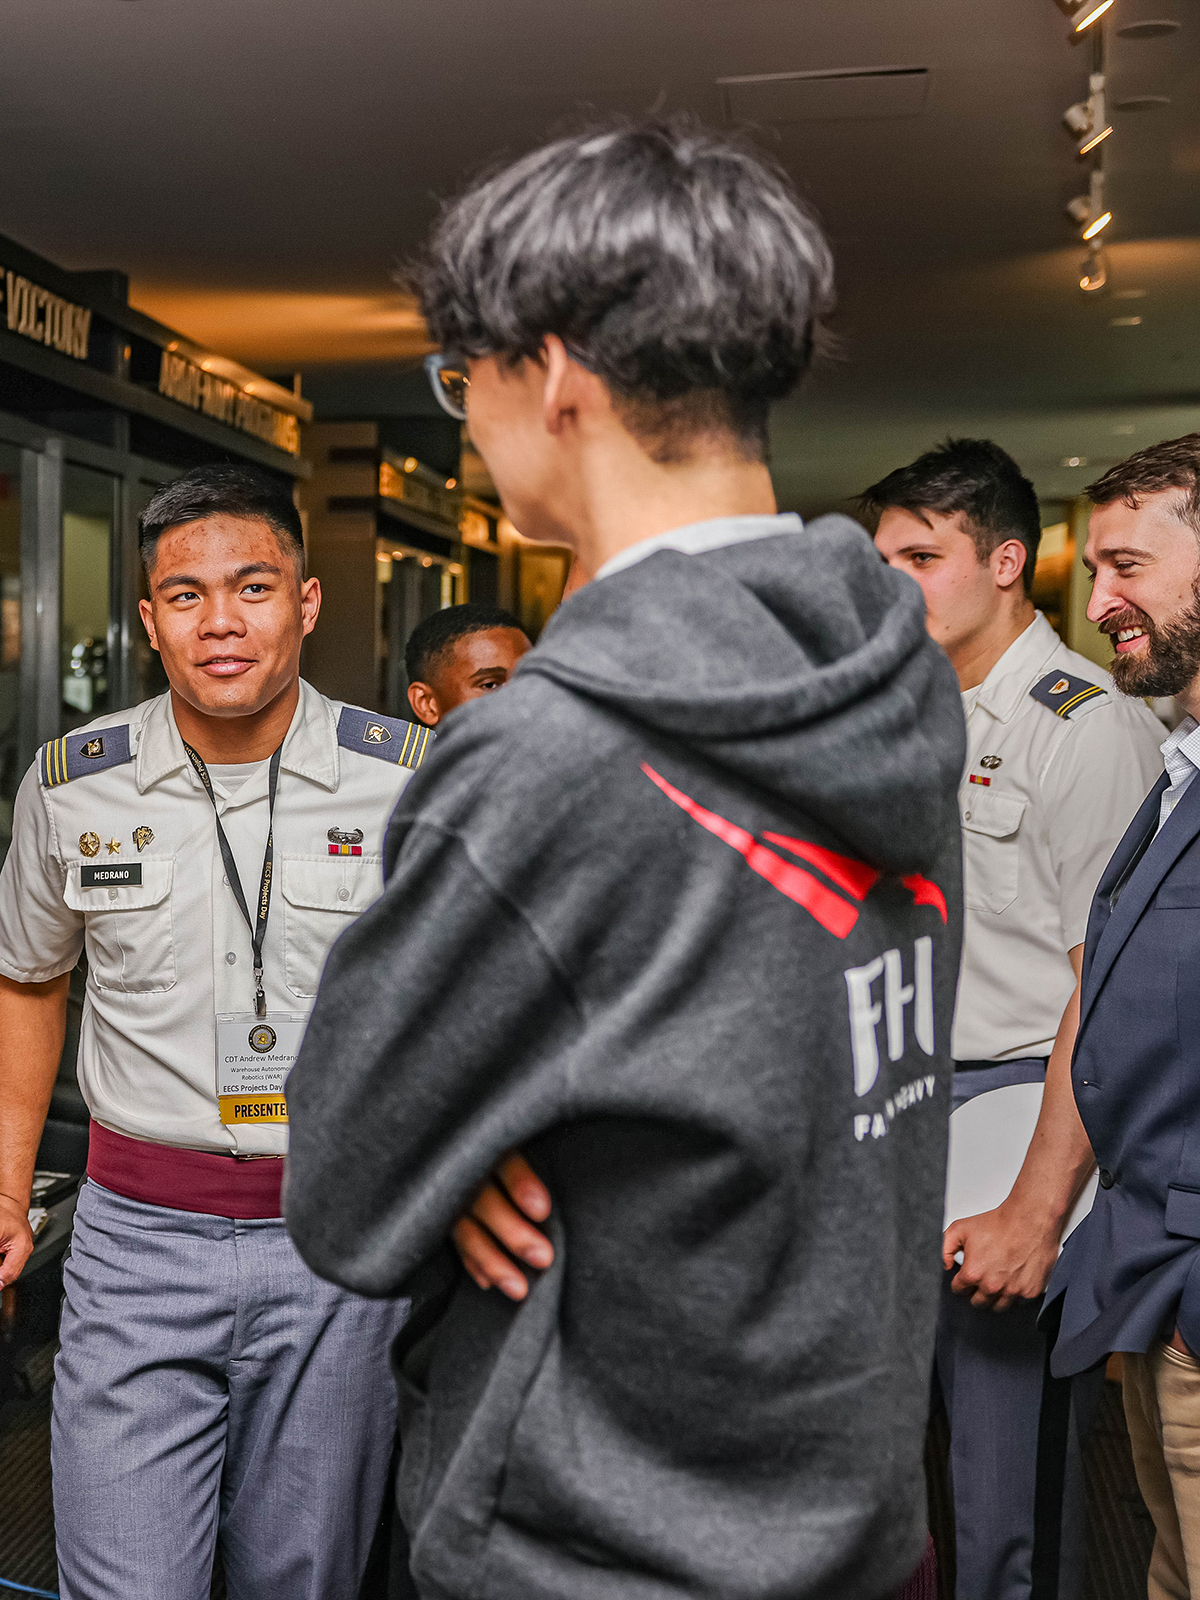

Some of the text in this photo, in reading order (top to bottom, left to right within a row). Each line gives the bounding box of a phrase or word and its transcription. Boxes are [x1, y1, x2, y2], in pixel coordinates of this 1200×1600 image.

[6, 271, 92, 360] VICTORY
[93, 870, 130, 881] MEDRANO
[259, 861, 273, 920] EECS Projects Day
[240, 1084, 268, 1093] Projects
[269, 1083, 283, 1092] Day
[234, 1102, 289, 1118] PRESENTE
